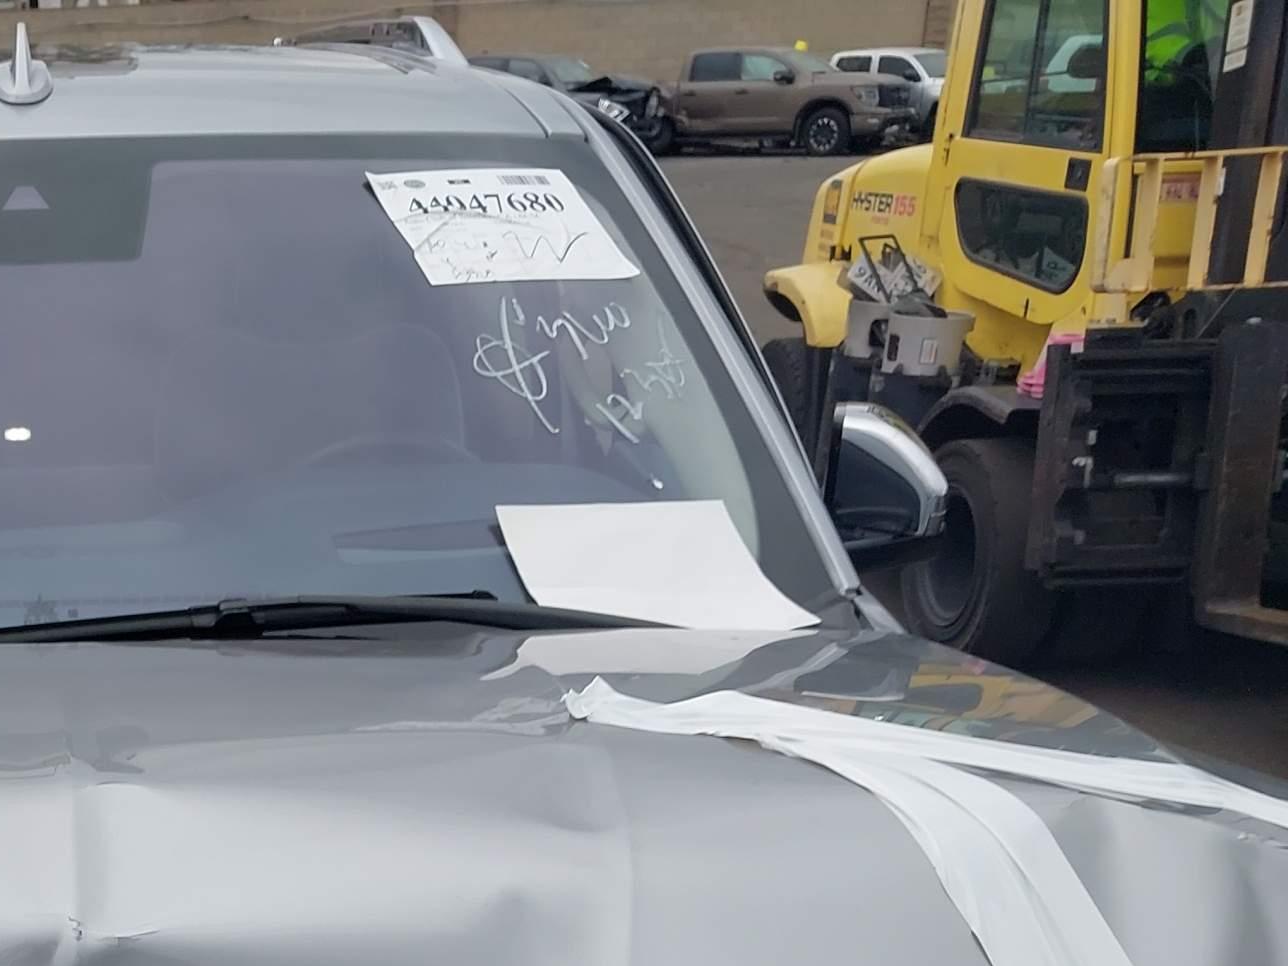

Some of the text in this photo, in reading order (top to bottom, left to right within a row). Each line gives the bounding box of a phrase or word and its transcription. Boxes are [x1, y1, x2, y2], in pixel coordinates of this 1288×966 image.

[409, 191, 565, 214] 44047680
[852, 190, 917, 216] HYSTER 155
